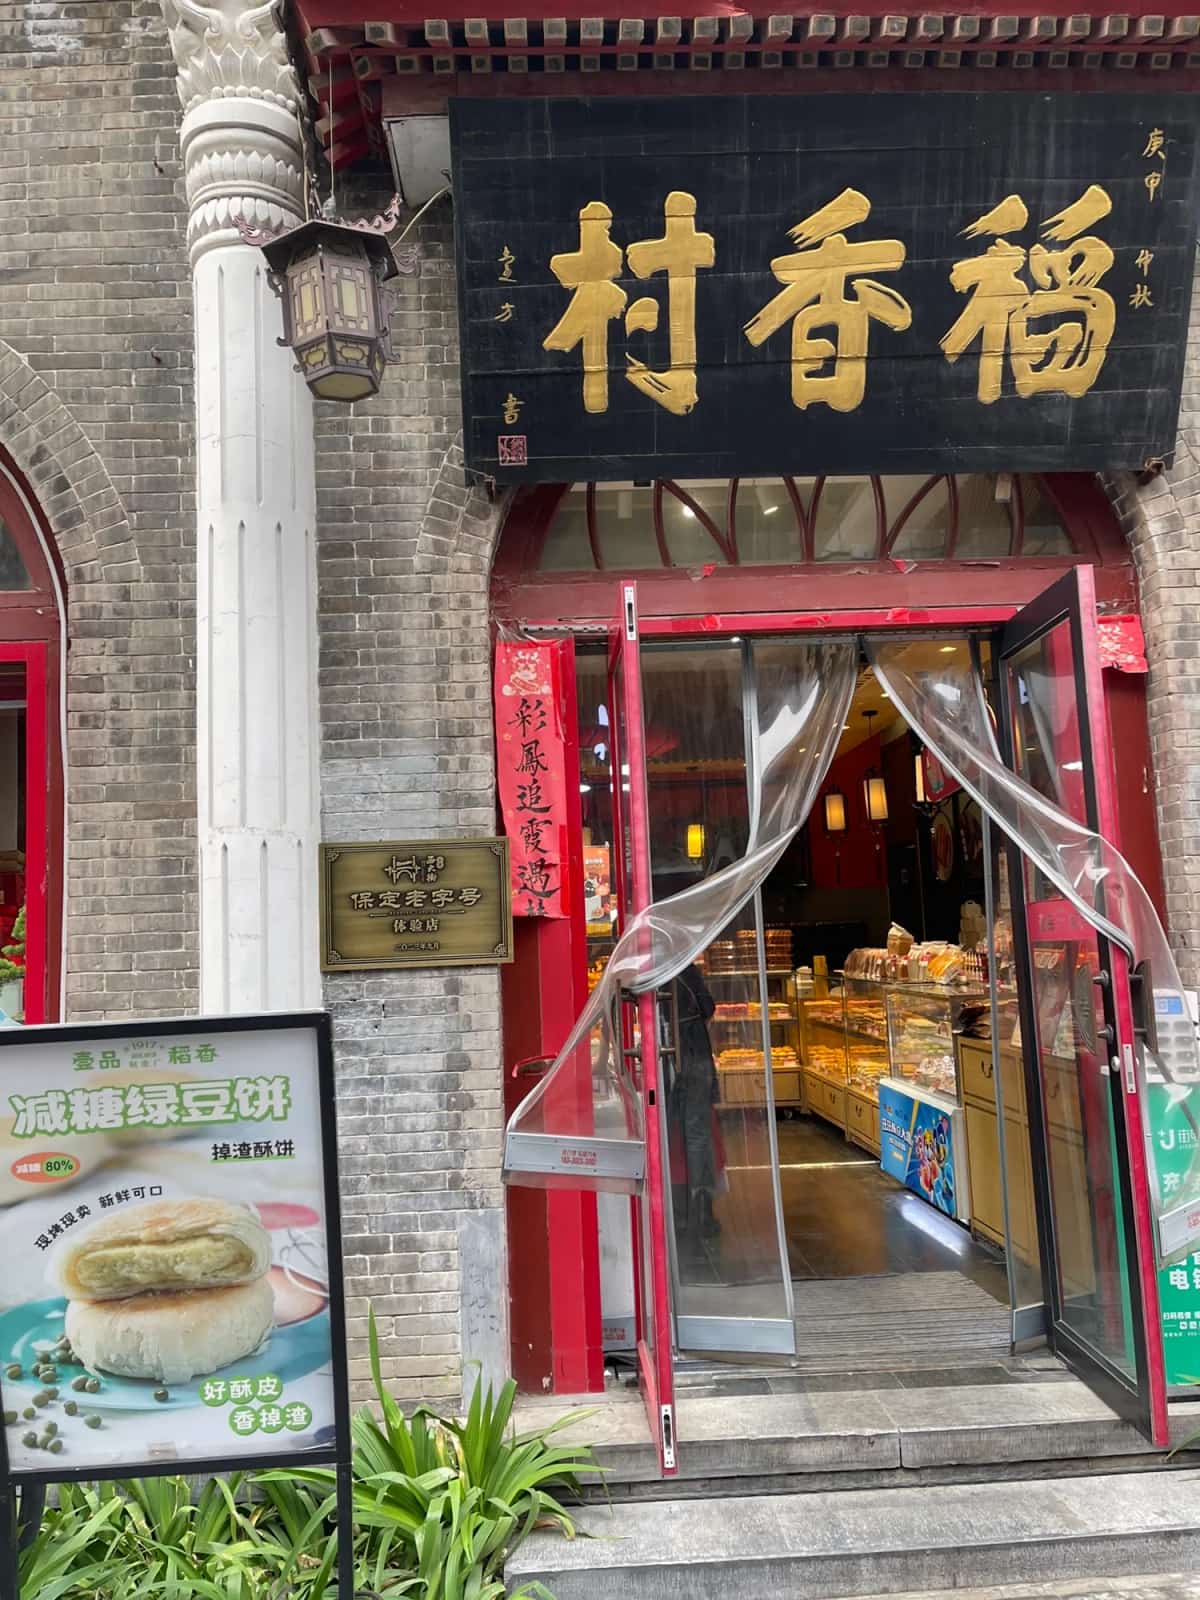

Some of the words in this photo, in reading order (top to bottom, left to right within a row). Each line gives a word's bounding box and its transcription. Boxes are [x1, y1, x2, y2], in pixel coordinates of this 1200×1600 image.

[542, 184, 1117, 416] 稻香村
[350, 887, 482, 910] 保定老字号
[393, 918, 439, 933] 体验店
[72, 1050, 121, 1071] 壹品
[168, 1043, 218, 1064] 稻香
[9, 1075, 292, 1139] 减糖绿豆饼
[211, 1139, 295, 1160] 掉渣酥饼
[45, 1159, 73, 1172] 80%
[34, 1204, 92, 1251] 现烤现卖
[98, 1185, 163, 1208] 新鲜可口
[204, 1376, 279, 1401] 好酥皮
[234, 1405, 308, 1430] 香掉渣
